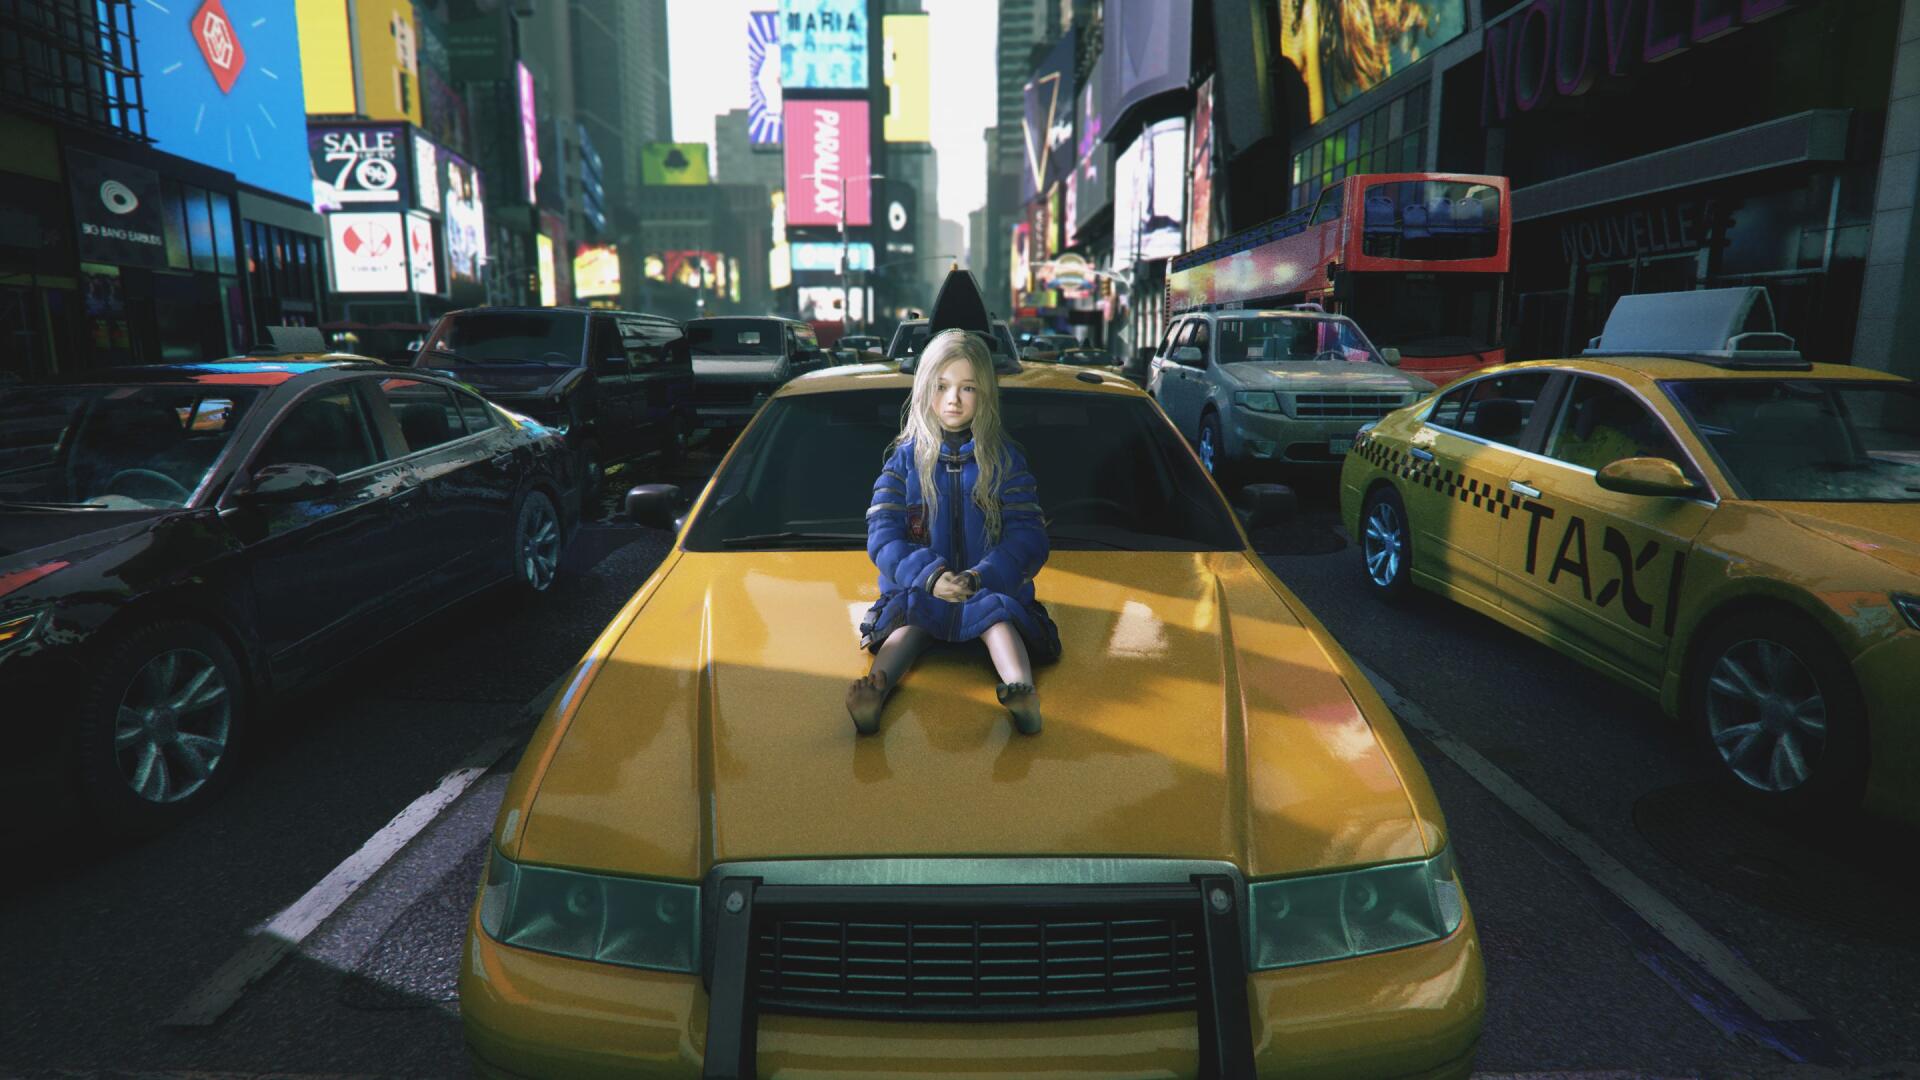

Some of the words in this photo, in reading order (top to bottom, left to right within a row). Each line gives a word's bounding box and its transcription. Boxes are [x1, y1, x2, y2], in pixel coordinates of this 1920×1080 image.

[787, 12, 859, 32] MARIA
[323, 132, 395, 152] SALE
[814, 108, 843, 218] PARALLAX
[81, 222, 99, 236] BIG
[101, 225, 127, 240] BANG
[1561, 202, 1697, 260] NOUVELLE
[1522, 500, 1686, 637] TAXI
